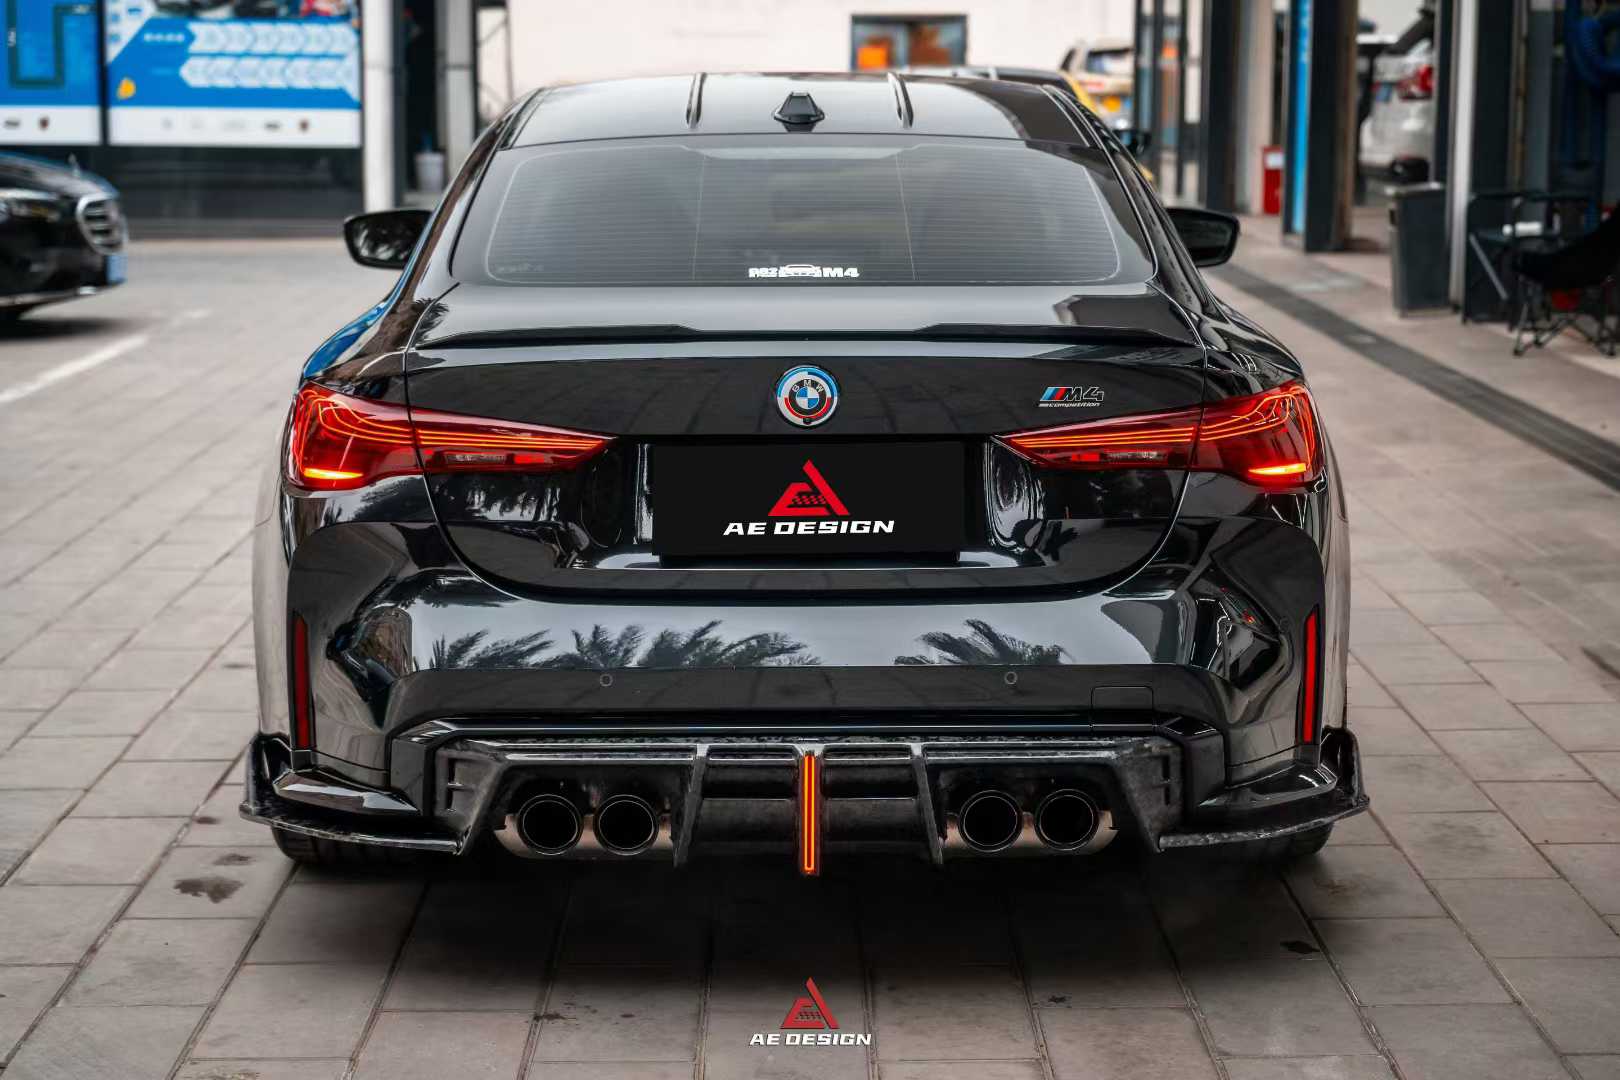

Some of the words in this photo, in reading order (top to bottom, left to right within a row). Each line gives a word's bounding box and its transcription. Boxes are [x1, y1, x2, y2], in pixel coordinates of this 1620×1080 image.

[822, 267, 860, 278] M4
[791, 379, 825, 393] BMW
[1060, 386, 1105, 402] M4
